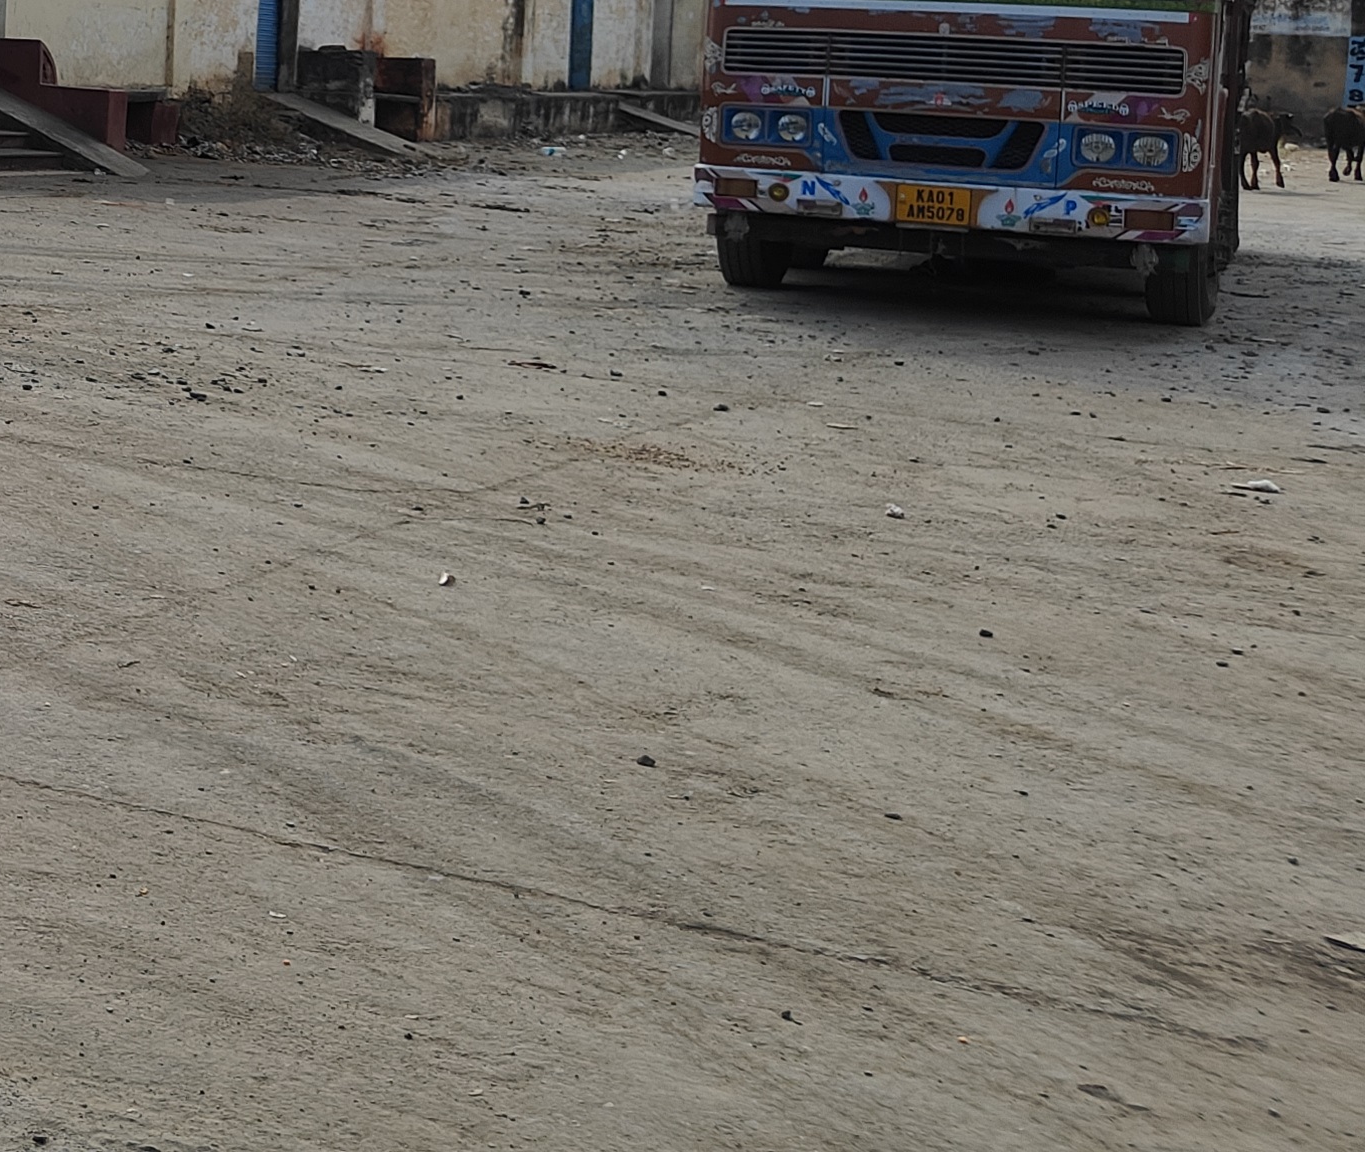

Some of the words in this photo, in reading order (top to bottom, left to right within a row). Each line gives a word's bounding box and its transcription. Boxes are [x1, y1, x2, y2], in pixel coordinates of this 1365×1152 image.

[1077, 100, 1120, 112] SPEED
[801, 180, 816, 196] N
[916, 189, 955, 205] KA01
[906, 203, 965, 223] AM5078
[1065, 200, 1078, 215] P
